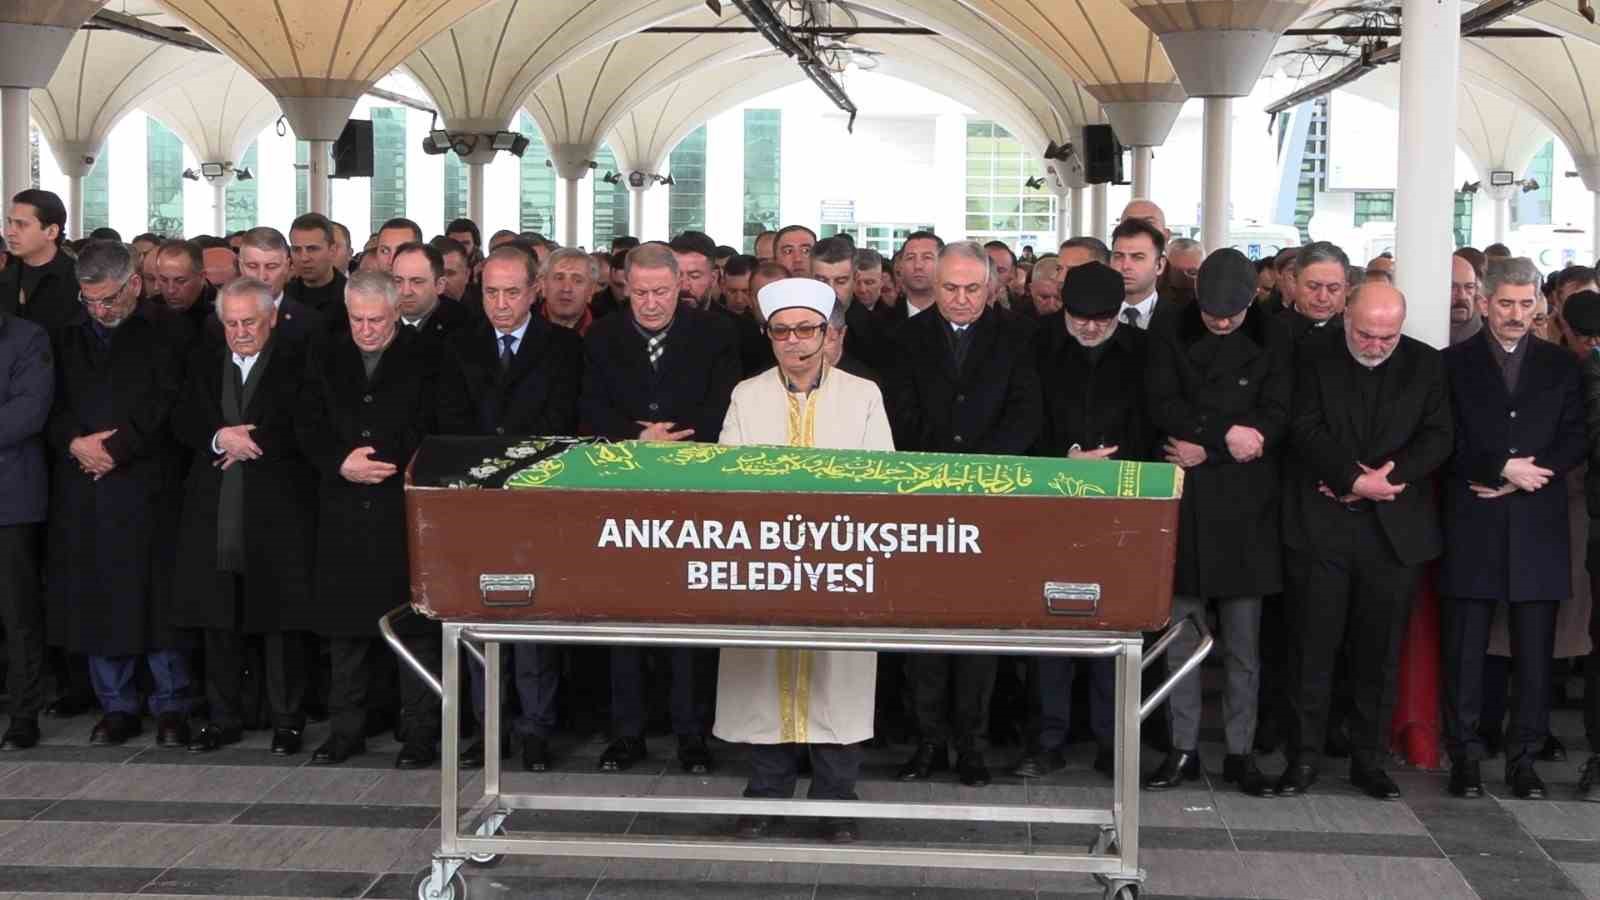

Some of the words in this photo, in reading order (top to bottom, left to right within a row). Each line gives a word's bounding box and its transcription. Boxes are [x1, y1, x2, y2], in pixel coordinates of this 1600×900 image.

[597, 518, 752, 550] ANKARA
[759, 513, 982, 558] BÜYÜKŞEHİR
[687, 556, 874, 593] BELEDİYESİ
